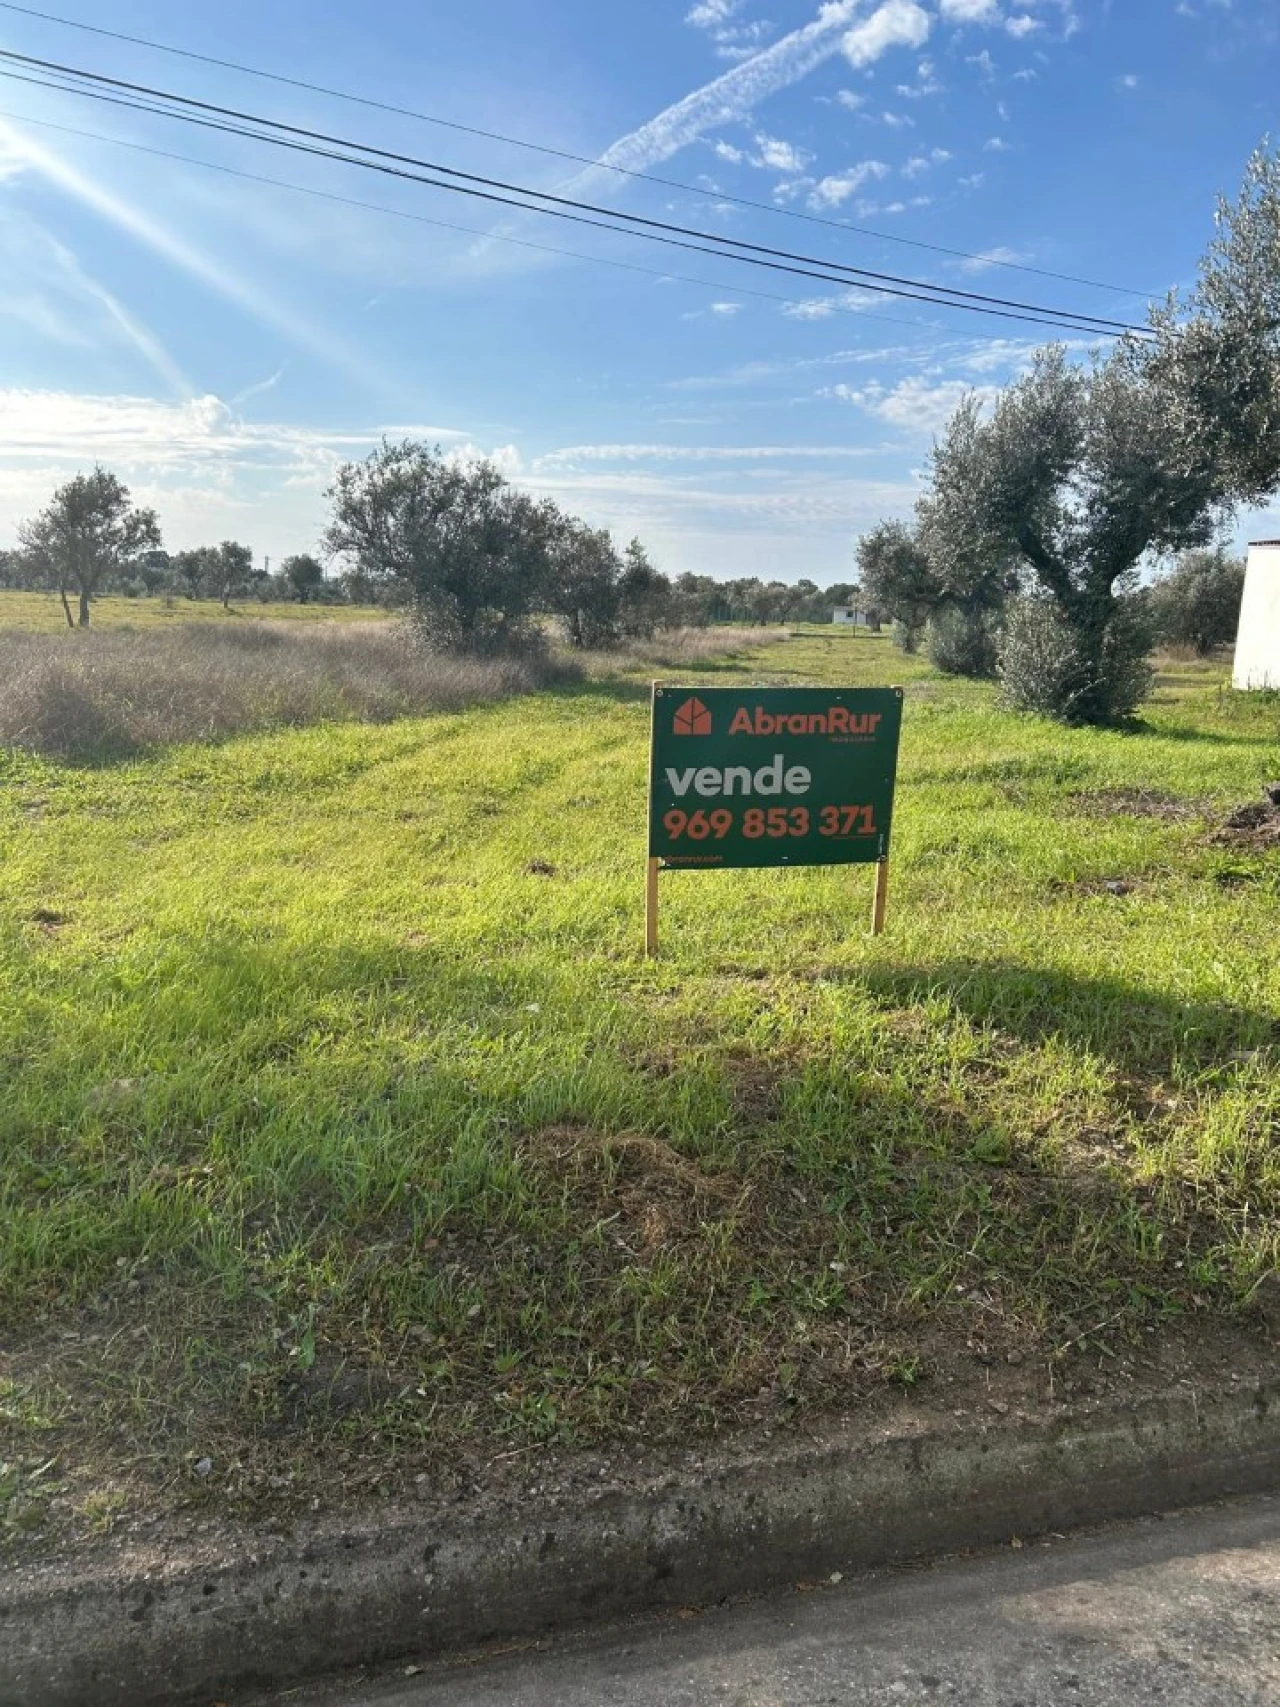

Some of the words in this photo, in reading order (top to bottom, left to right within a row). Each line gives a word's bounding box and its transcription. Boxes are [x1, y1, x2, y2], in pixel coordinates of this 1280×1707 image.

[729, 706, 881, 735] AbranRur
[665, 754, 811, 796] vende
[664, 808, 733, 840] 969
[742, 807, 810, 838] 853
[818, 805, 877, 836] 371
